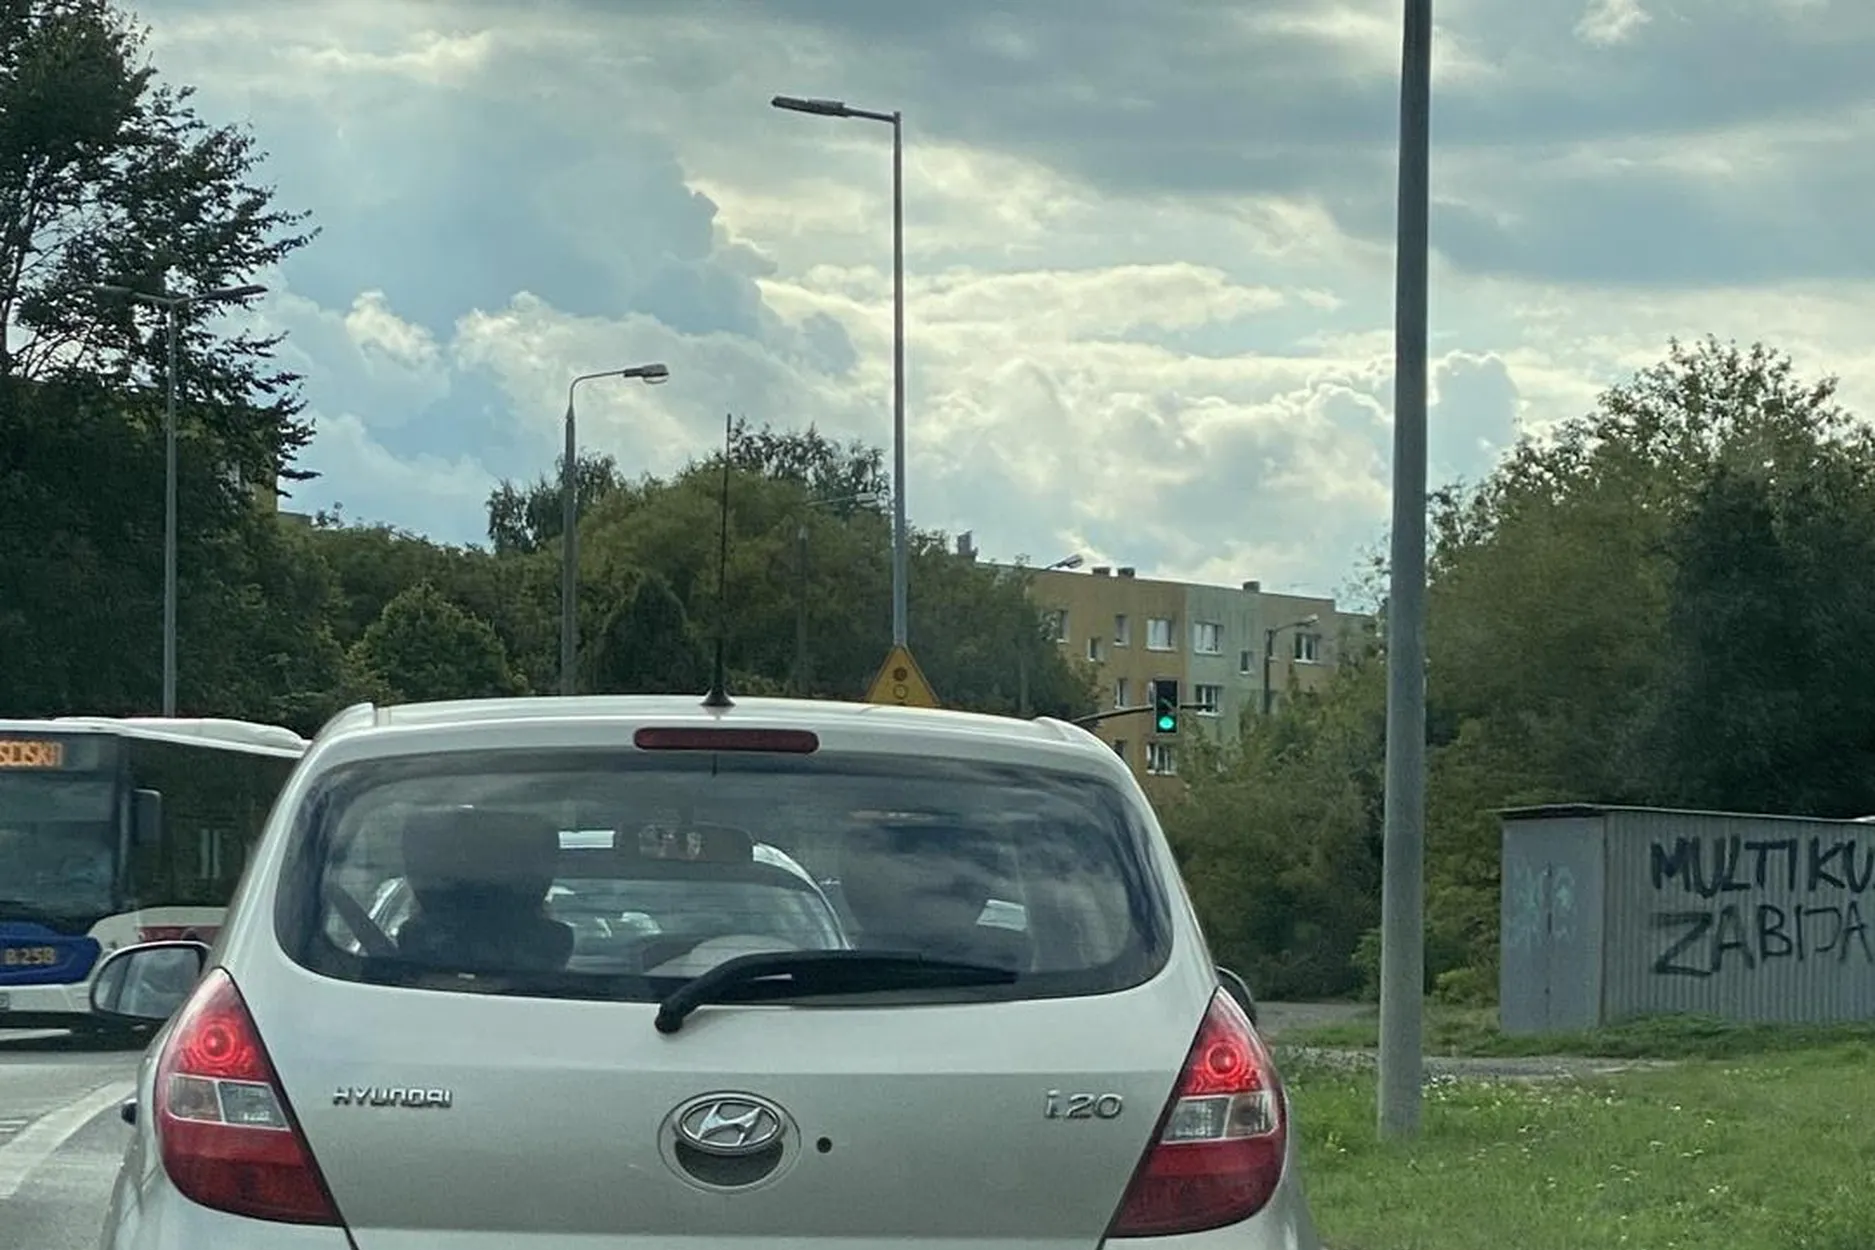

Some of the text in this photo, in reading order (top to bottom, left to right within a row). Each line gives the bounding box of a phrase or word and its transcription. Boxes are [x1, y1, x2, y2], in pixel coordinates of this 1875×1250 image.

[1651, 835, 1875, 899] MULTIKU
[1651, 900, 1874, 977] ZABIJA
[333, 1087, 452, 1107] HYUNDAI
[1045, 1090, 1123, 1119] i20
